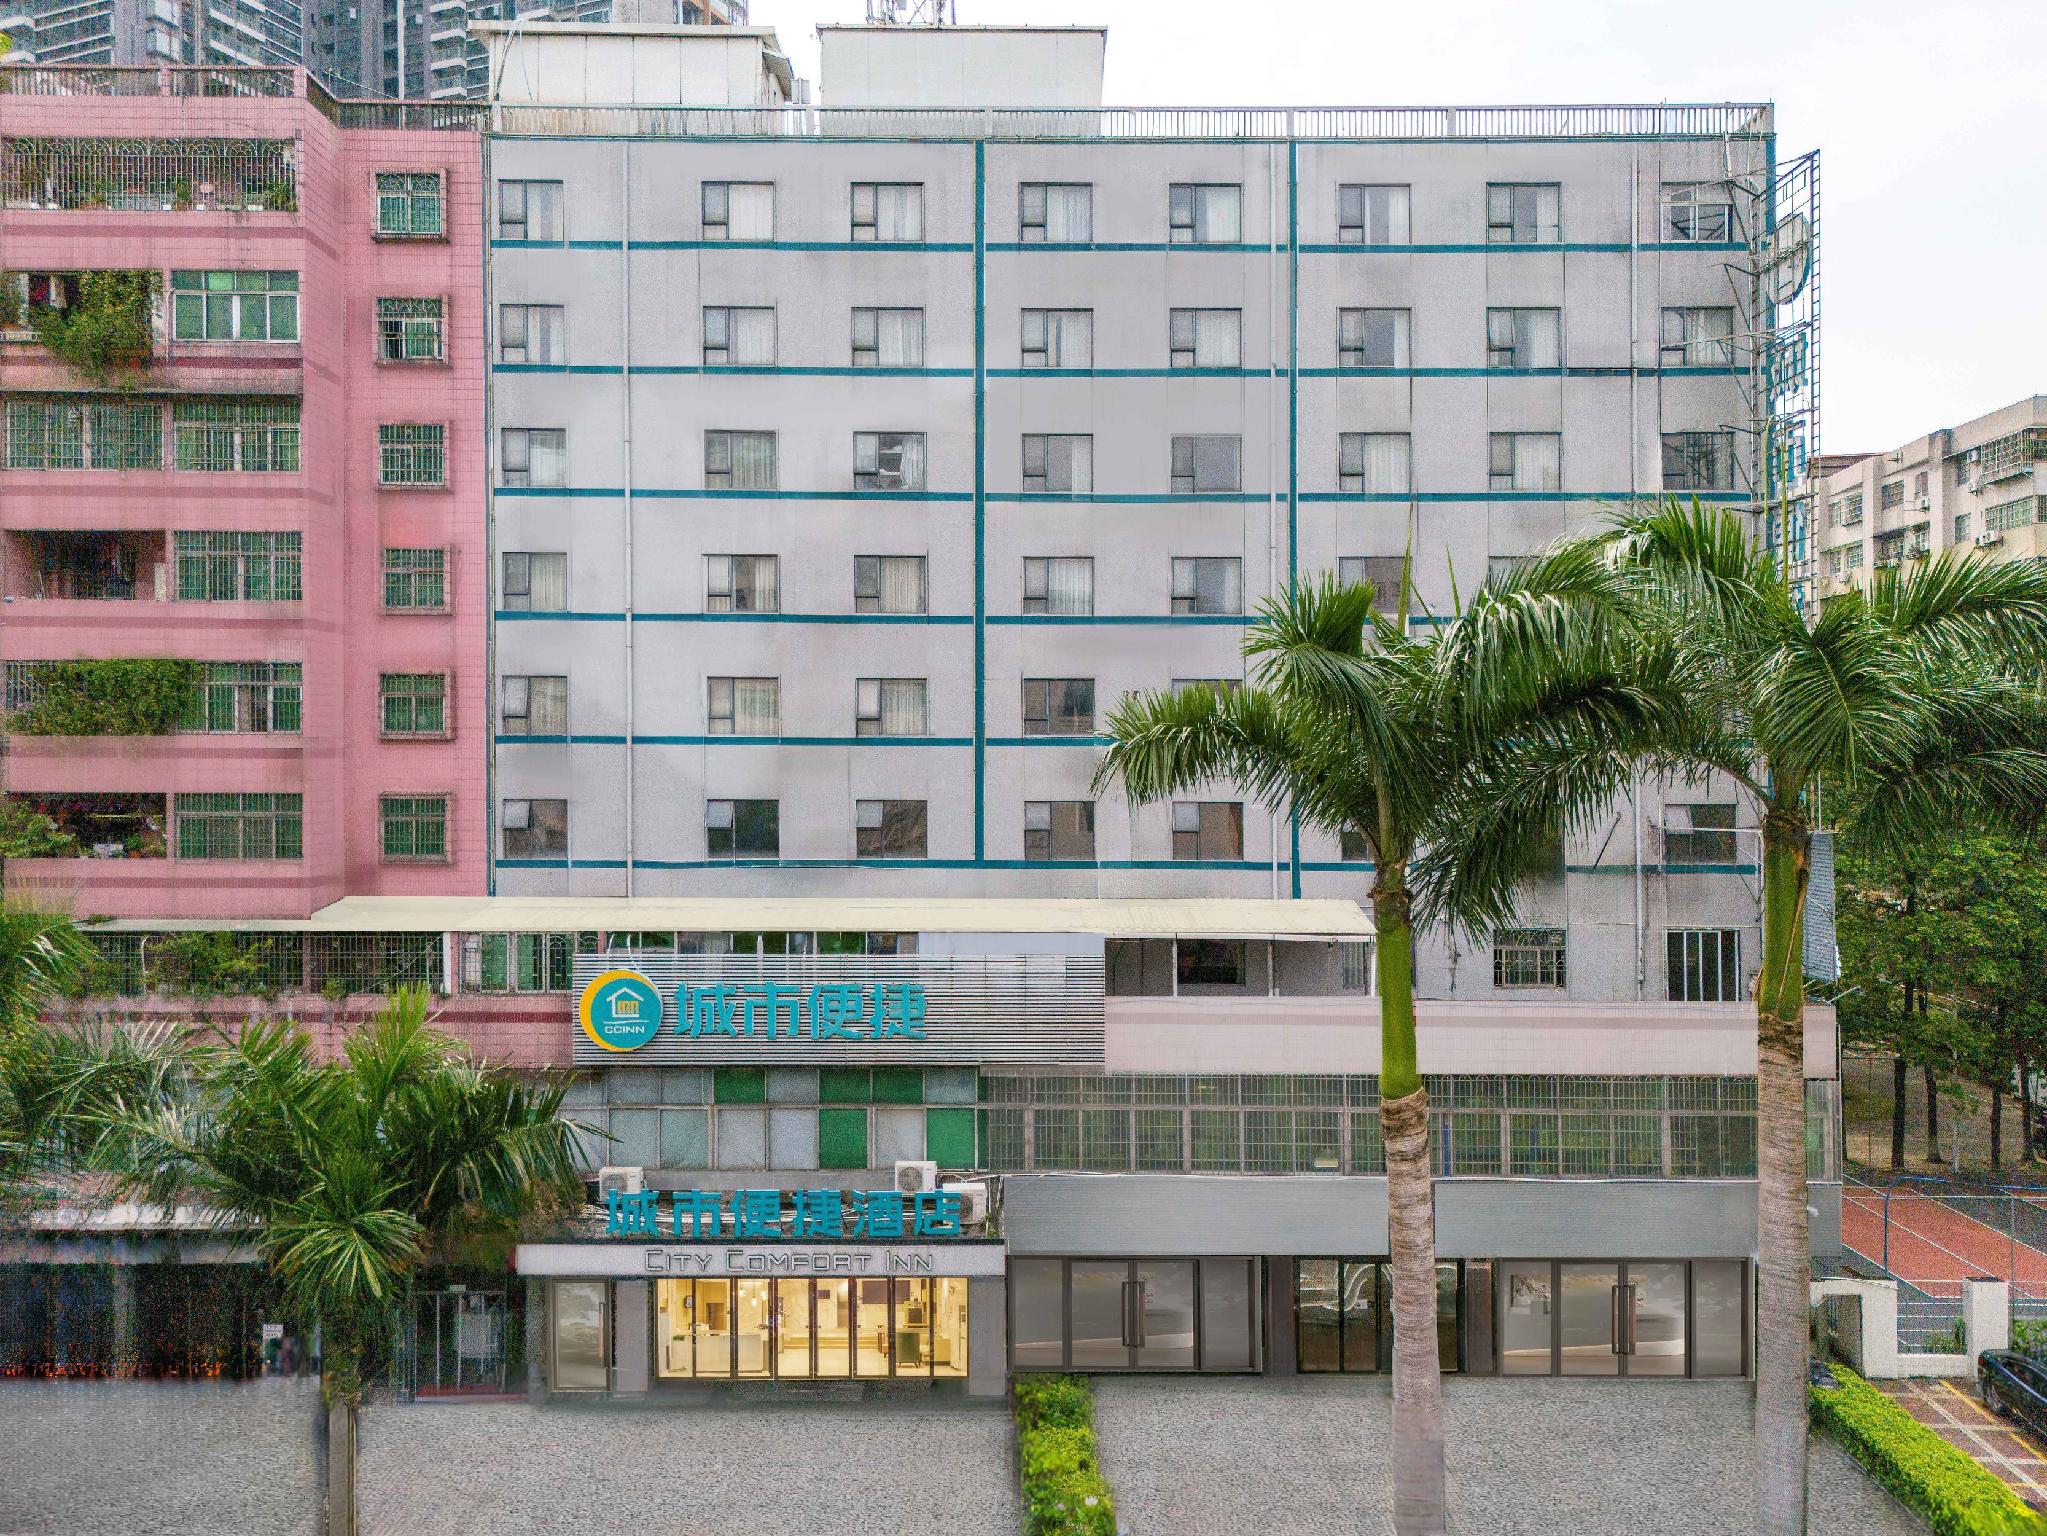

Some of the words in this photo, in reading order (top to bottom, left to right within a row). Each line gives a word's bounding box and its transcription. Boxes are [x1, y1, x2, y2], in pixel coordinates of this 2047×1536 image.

[674, 981, 927, 1040] 城市便捷
[606, 1188, 960, 1238] 城市便捷酒店
[645, 1249, 712, 1271] CITY
[726, 1249, 871, 1271] COMFORT
[886, 1250, 932, 1271] INN
